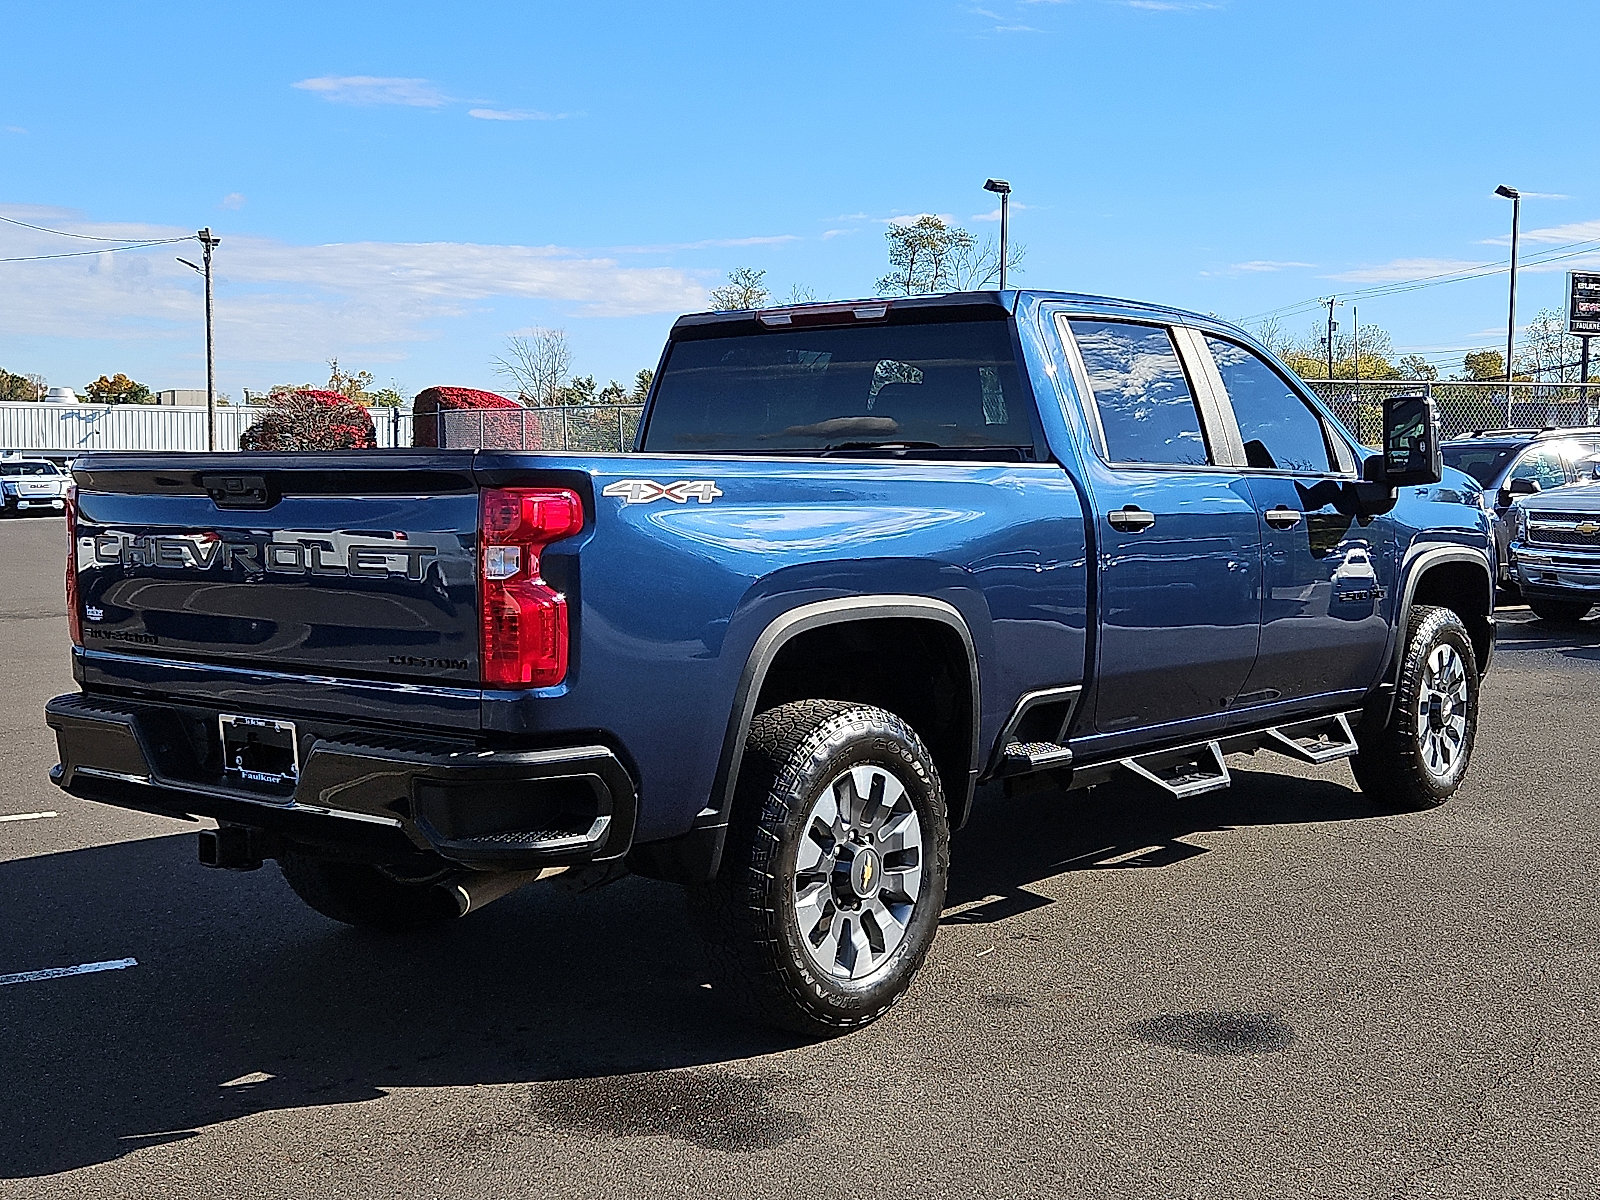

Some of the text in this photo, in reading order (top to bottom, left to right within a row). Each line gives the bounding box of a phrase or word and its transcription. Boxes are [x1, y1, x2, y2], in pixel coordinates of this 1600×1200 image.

[92, 535, 438, 582] CHEVROLET
[387, 655, 469, 670] CUSTOM
[241, 771, 281, 783] Faulkner
